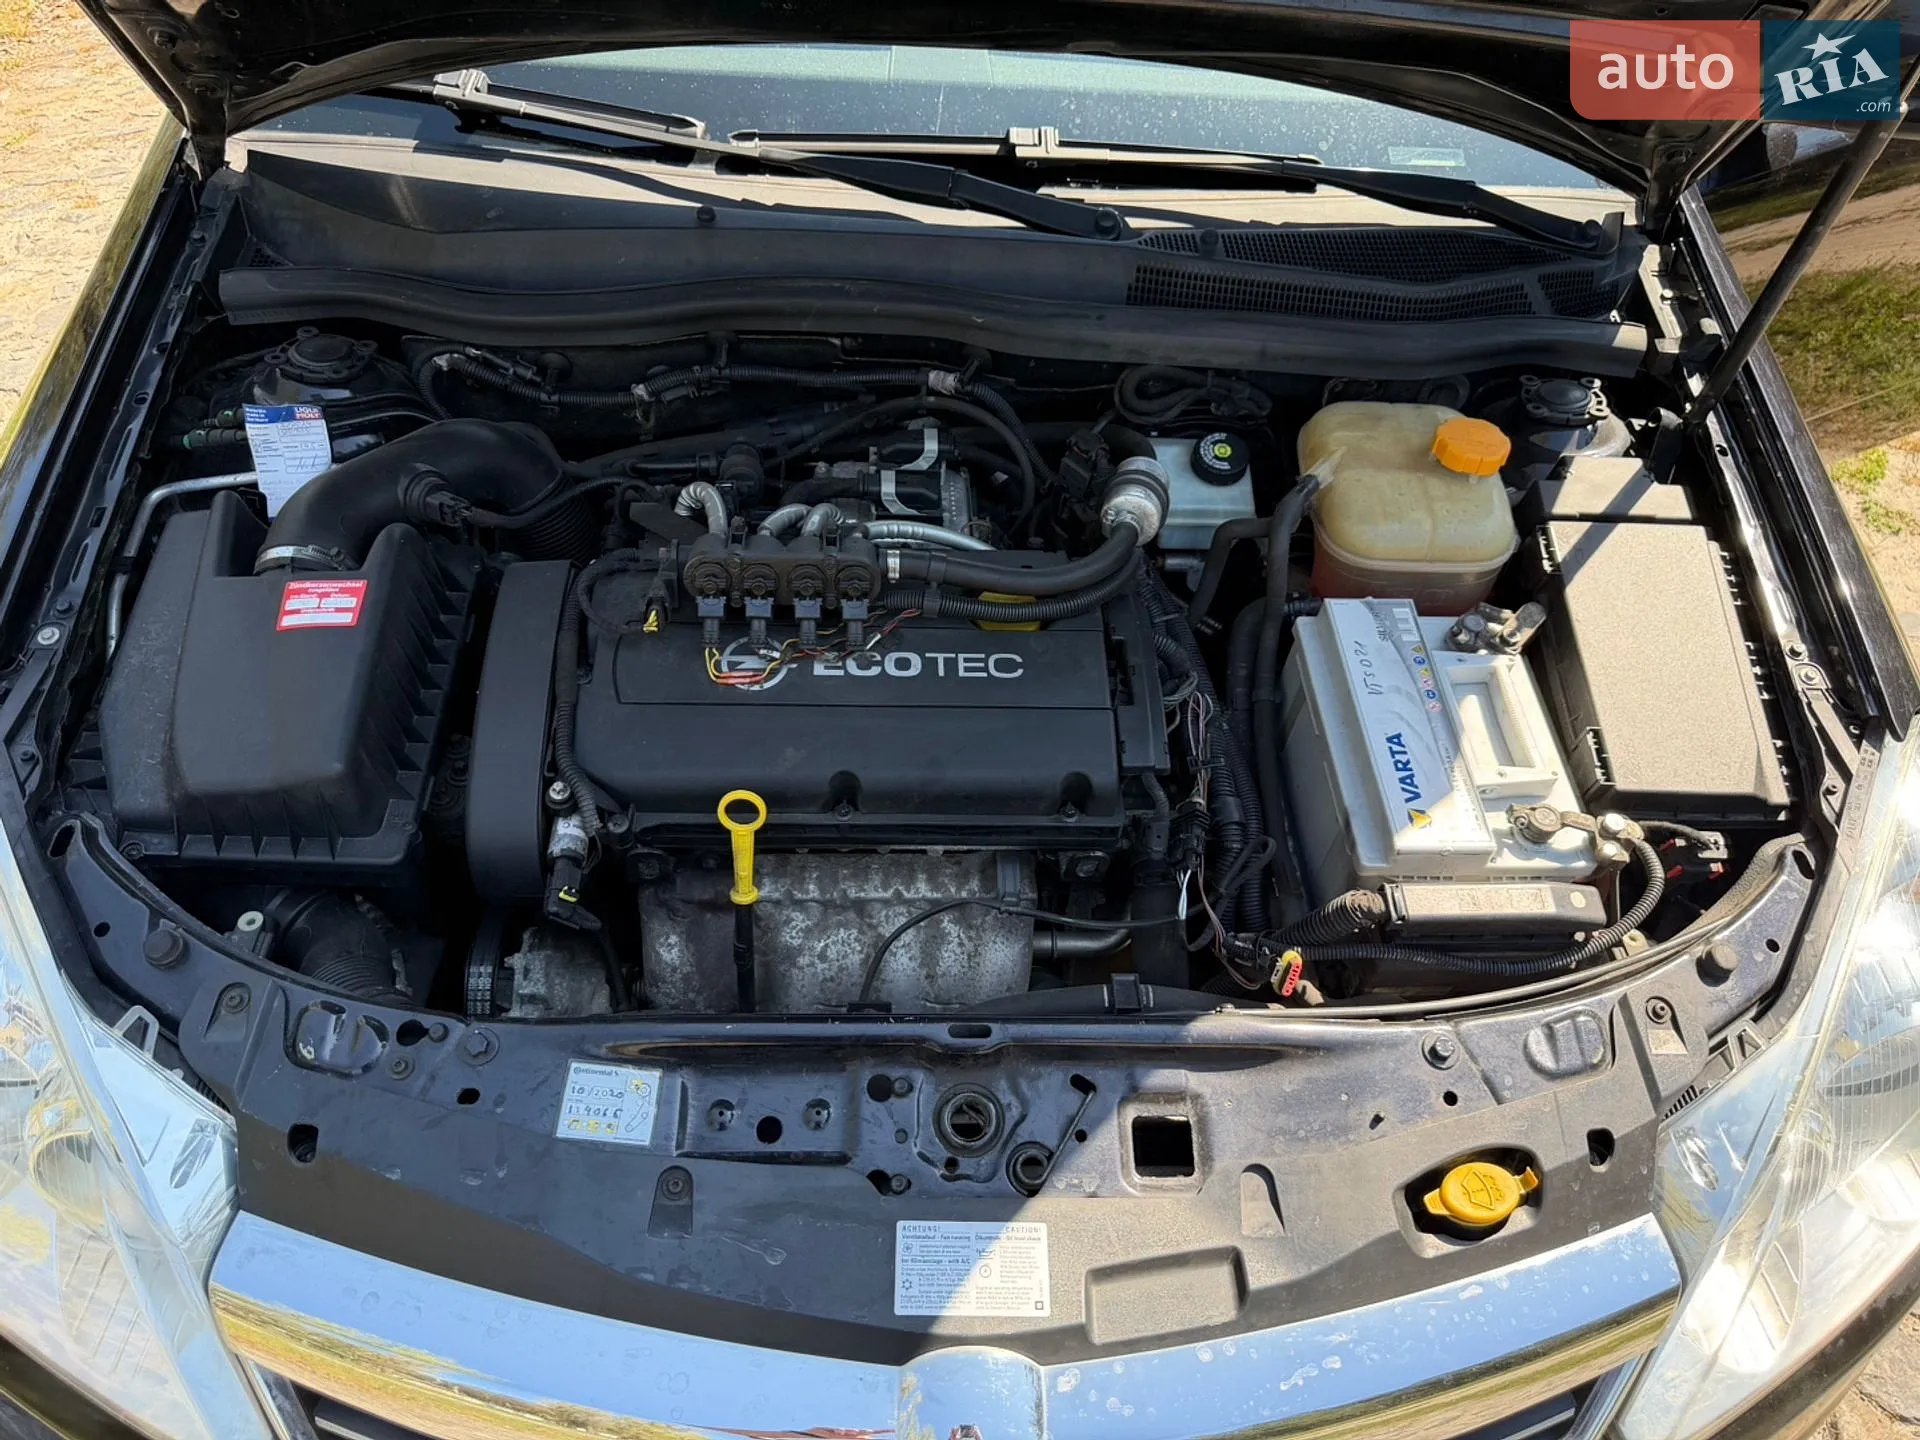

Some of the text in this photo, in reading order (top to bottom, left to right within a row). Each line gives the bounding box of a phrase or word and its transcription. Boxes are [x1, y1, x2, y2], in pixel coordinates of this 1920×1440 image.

[812, 651, 1025, 679] ECOTEC
[1385, 732, 1422, 804] VARTA
[902, 1225, 941, 1233] ACHTUNG!
[1005, 1226, 1041, 1234] CAUTION!
